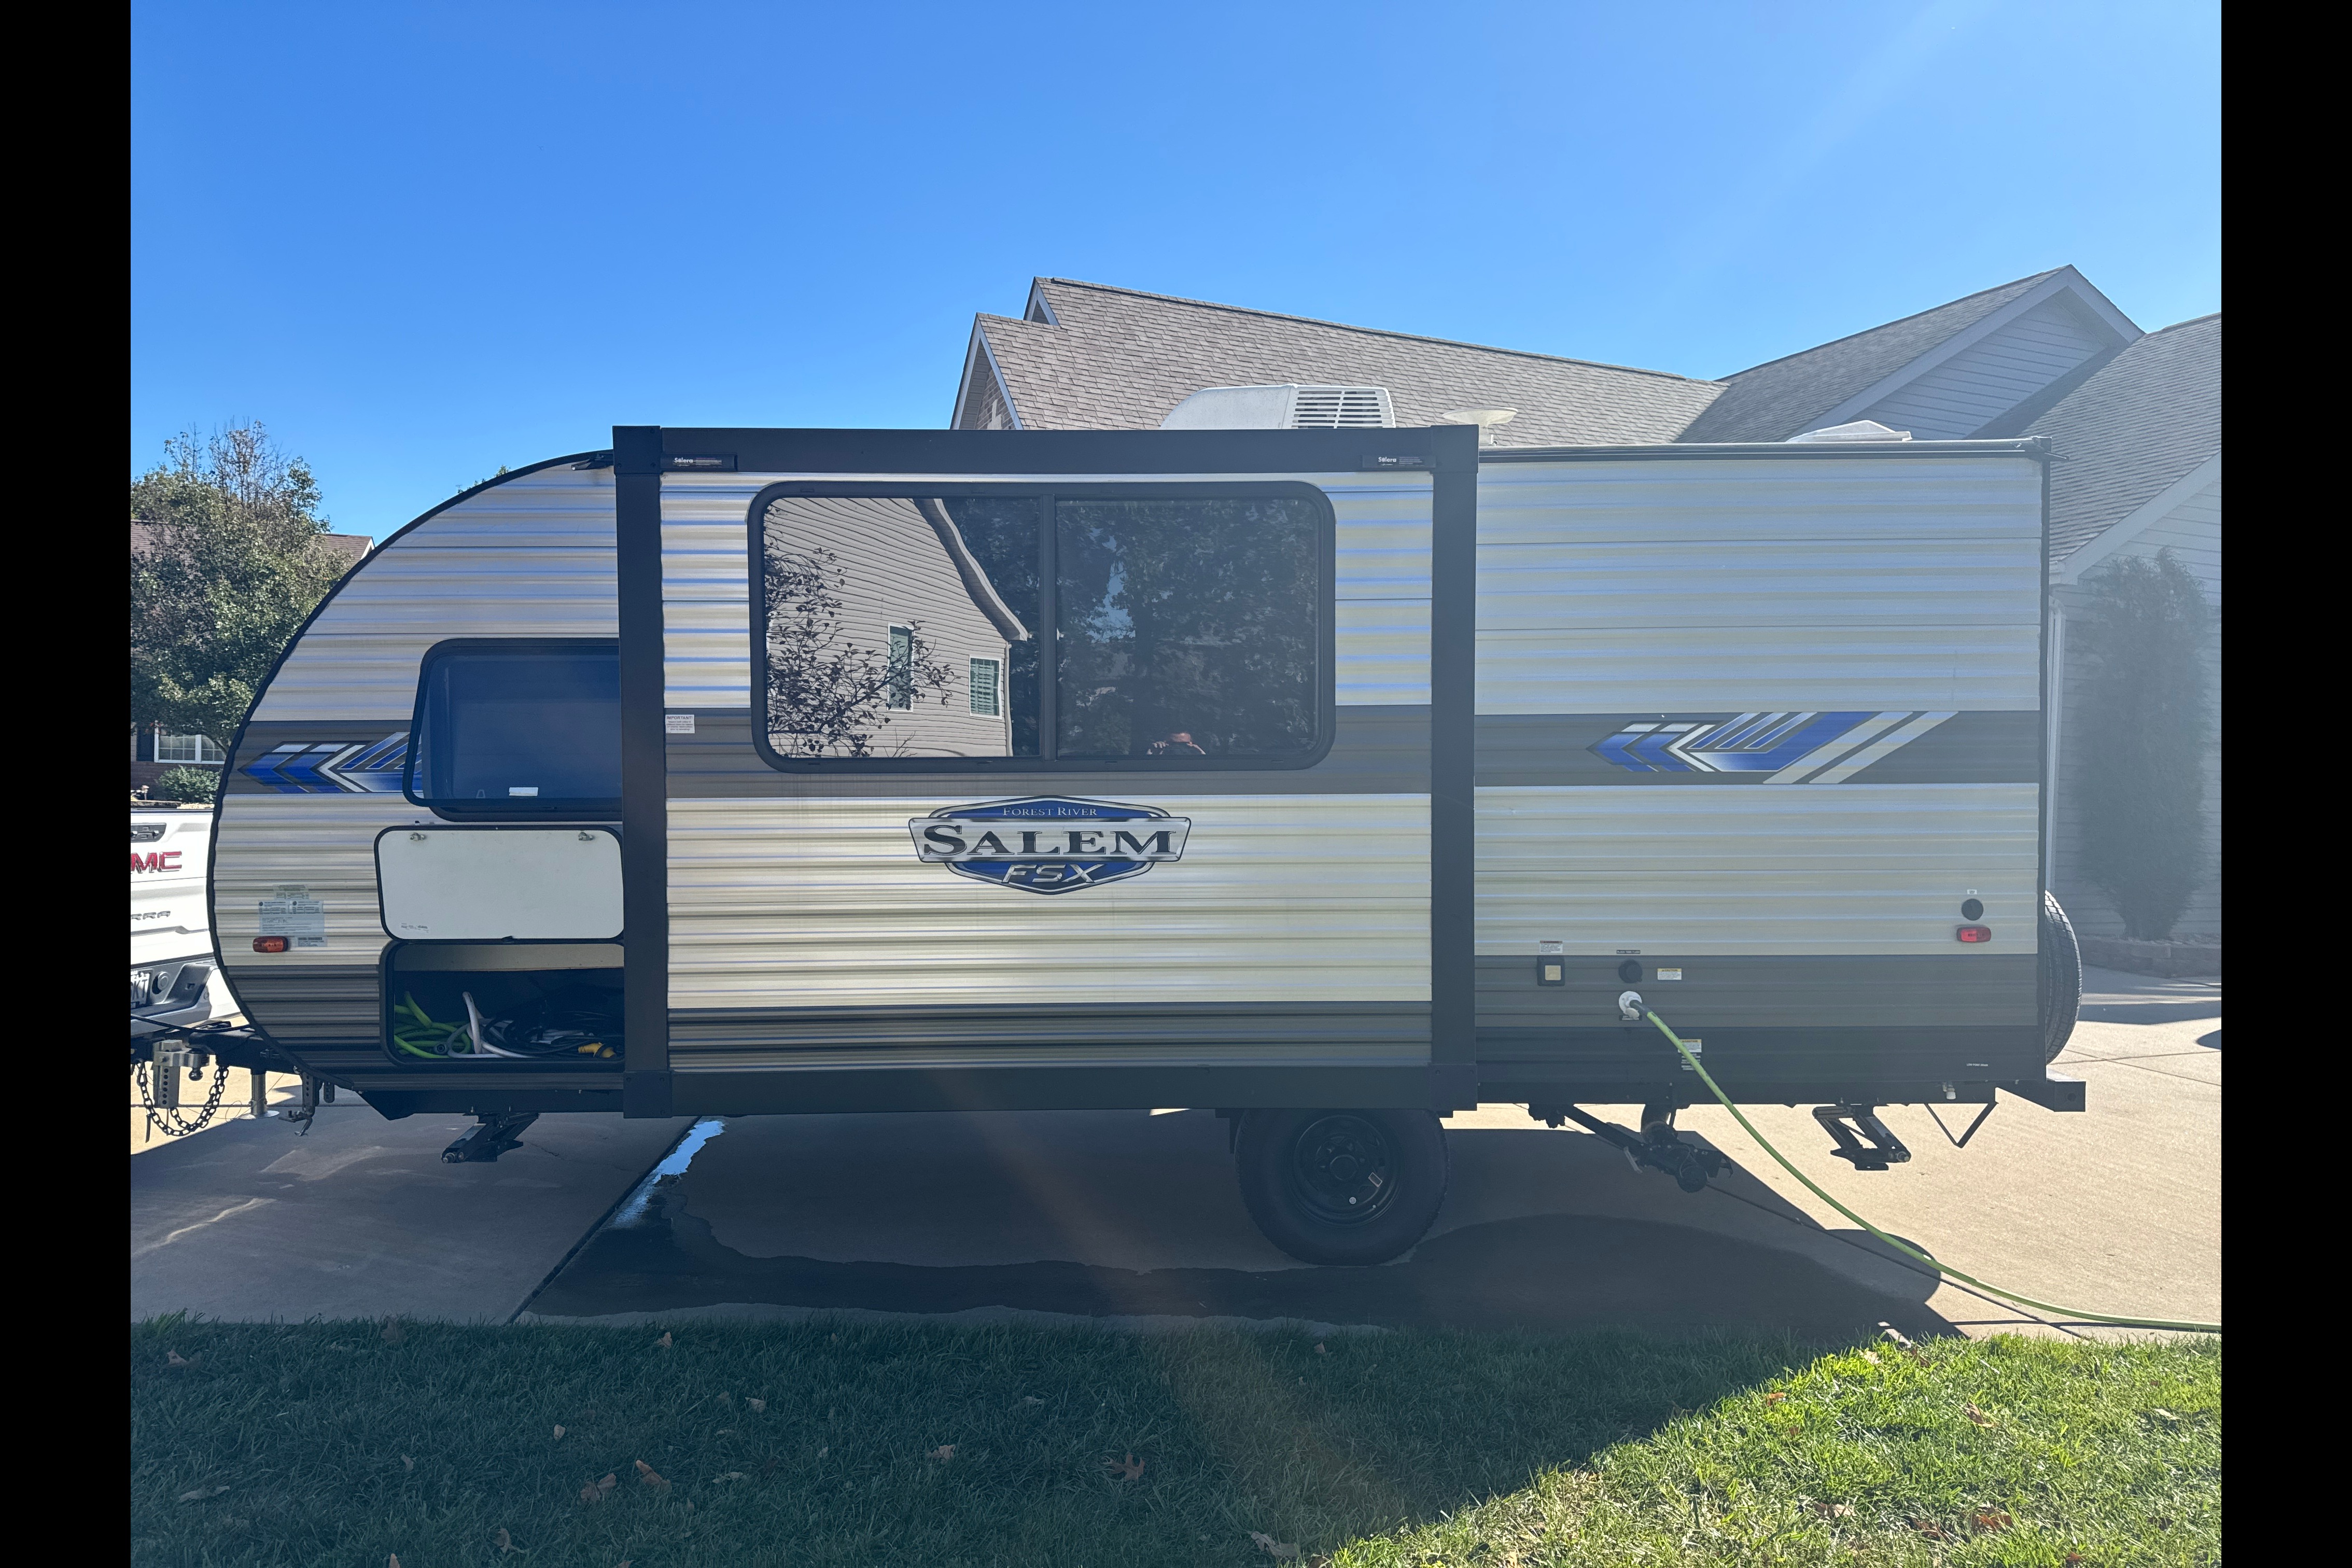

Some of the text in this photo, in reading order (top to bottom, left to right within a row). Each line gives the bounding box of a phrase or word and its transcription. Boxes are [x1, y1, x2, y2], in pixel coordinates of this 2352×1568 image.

[1002, 807, 1098, 816] FOREST RIVER
[923, 824, 1177, 856] SALEM
[1002, 864, 1107, 883] FSX
